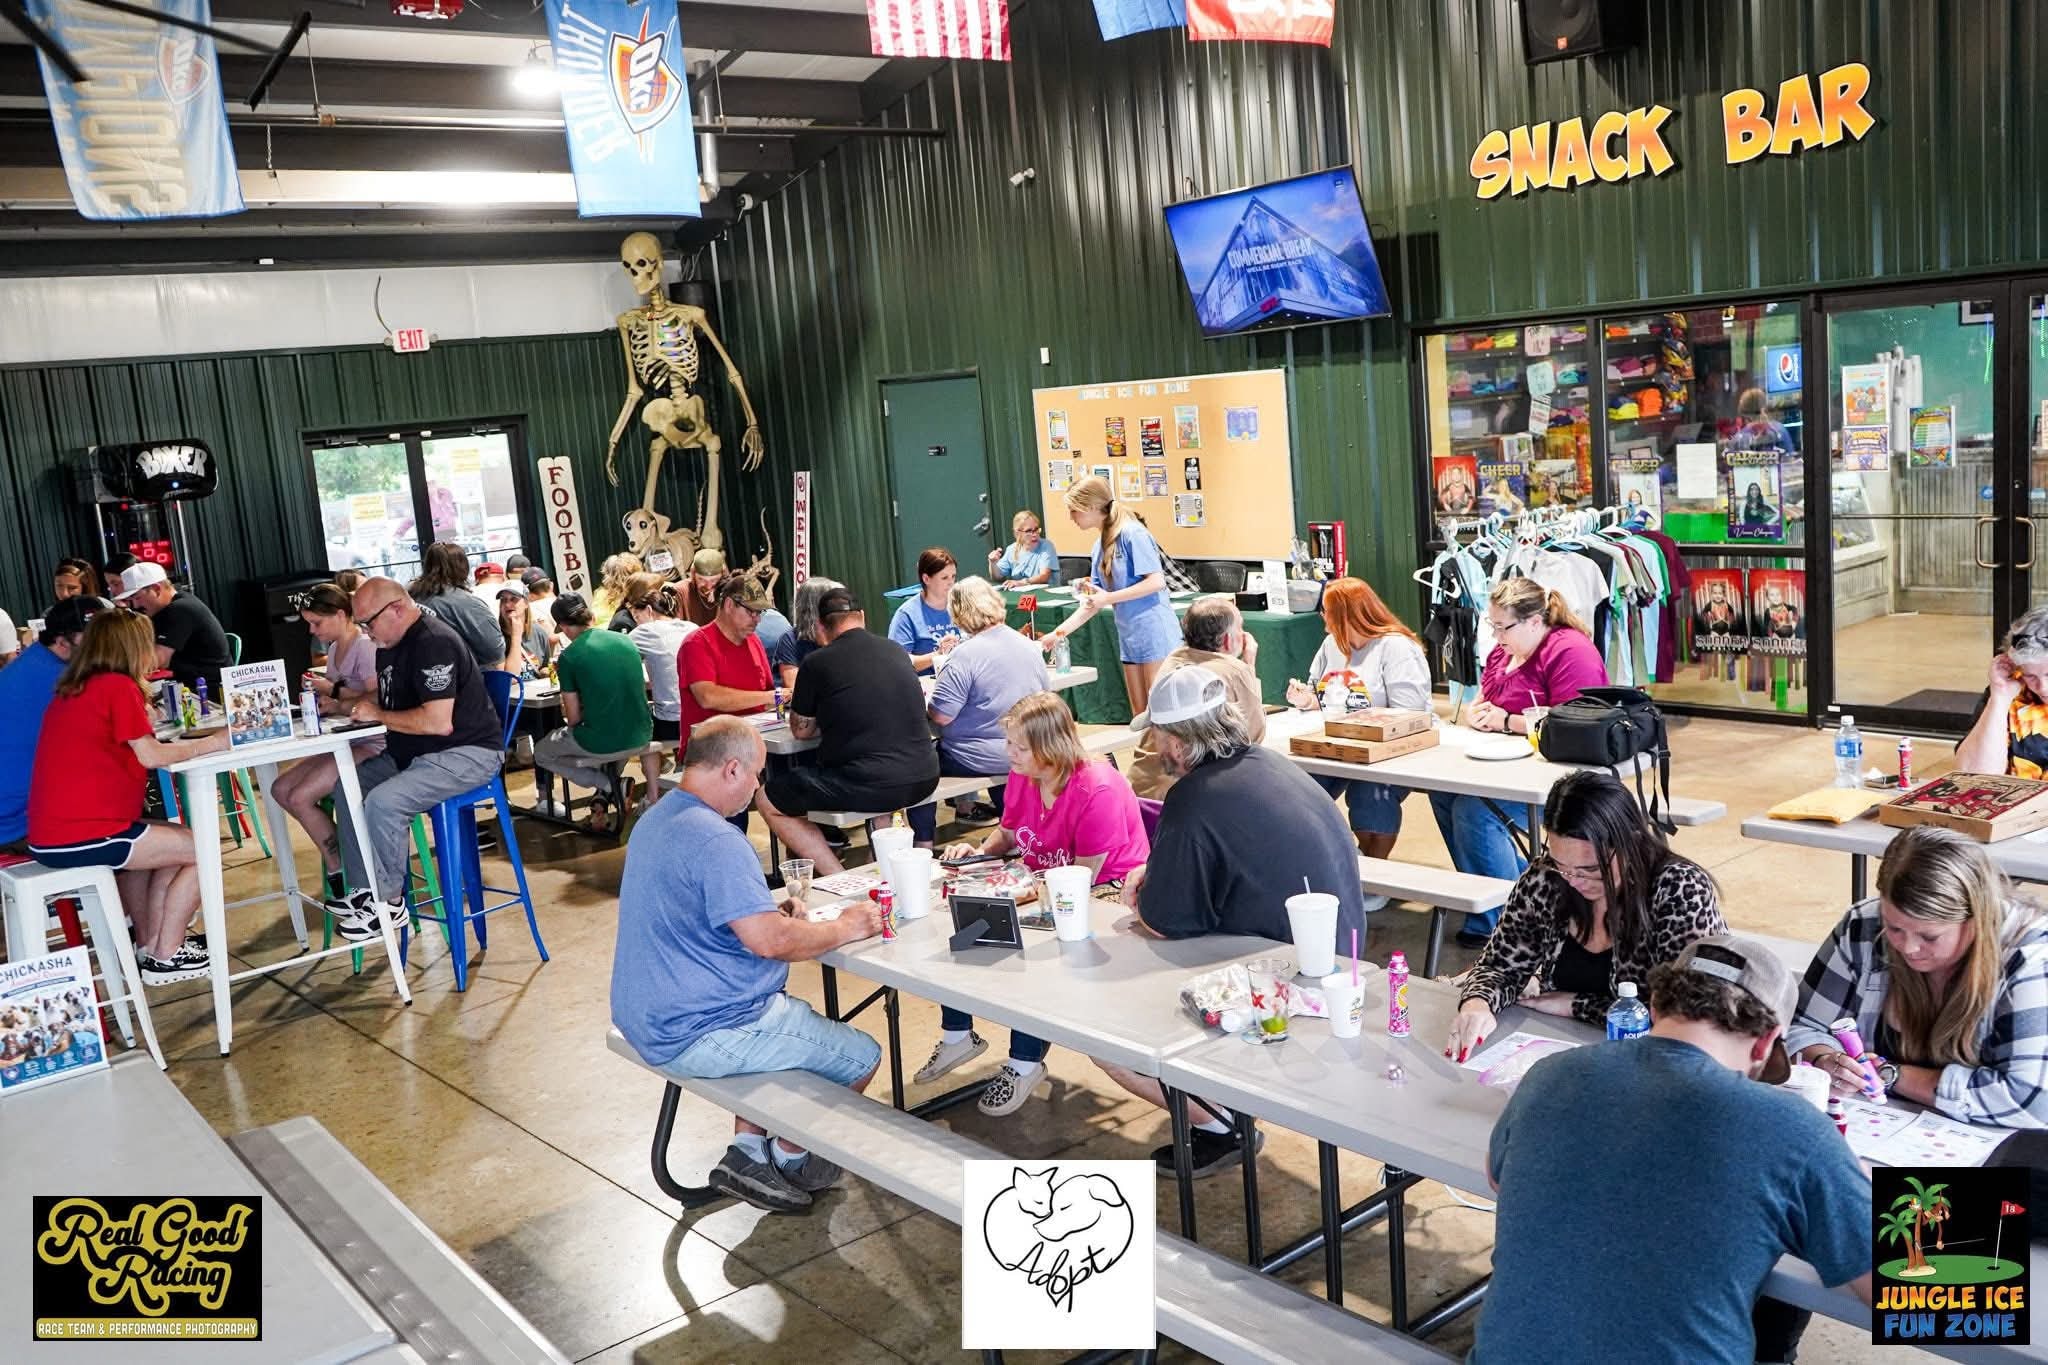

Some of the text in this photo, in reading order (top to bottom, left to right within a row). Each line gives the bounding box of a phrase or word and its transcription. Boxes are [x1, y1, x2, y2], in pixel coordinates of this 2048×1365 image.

[1470, 63, 1877, 199] SNACK BAR
[1227, 238, 1312, 269] COMMERCIAL BREAK
[398, 328, 424, 350] EXIT
[1139, 383, 1157, 396] FUN
[1163, 380, 1191, 394] ZONE
[136, 445, 208, 480] BOXER
[1480, 464, 1522, 477] CHEER
[547, 466, 582, 571] FOOTB
[796, 500, 806, 592] WELCO
[231, 664, 276, 679] CHICKASHA
